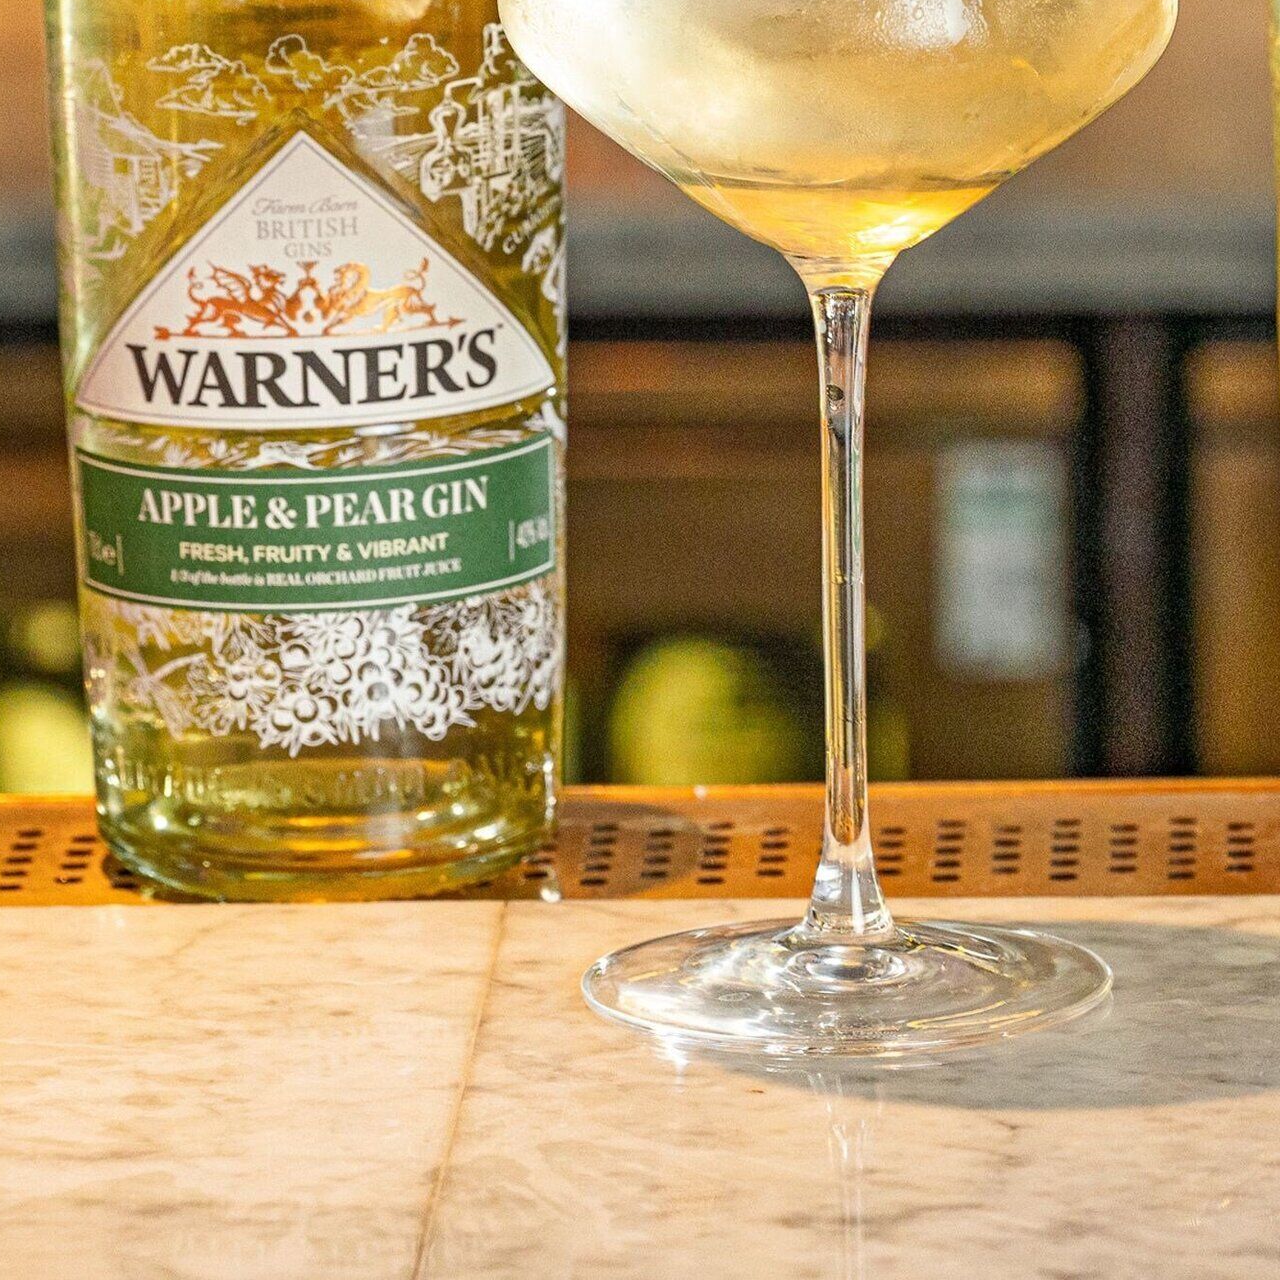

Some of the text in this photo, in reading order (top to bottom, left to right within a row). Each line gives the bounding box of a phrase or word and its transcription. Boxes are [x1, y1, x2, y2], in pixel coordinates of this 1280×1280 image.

[251, 196, 358, 216] Farm Born
[256, 217, 359, 240] BRITISH
[283, 241, 333, 259] GINS
[126, 327, 498, 409] WARNER'S
[137, 475, 489, 530] APPLE & PEAR GIN
[178, 531, 450, 564] FRESH, FRUITY & VIBRANT
[266, 571, 305, 587] REAL
[305, 568, 378, 587] ORCHARD
[377, 562, 422, 582] FRUIT
[421, 557, 462, 577] JUICE
